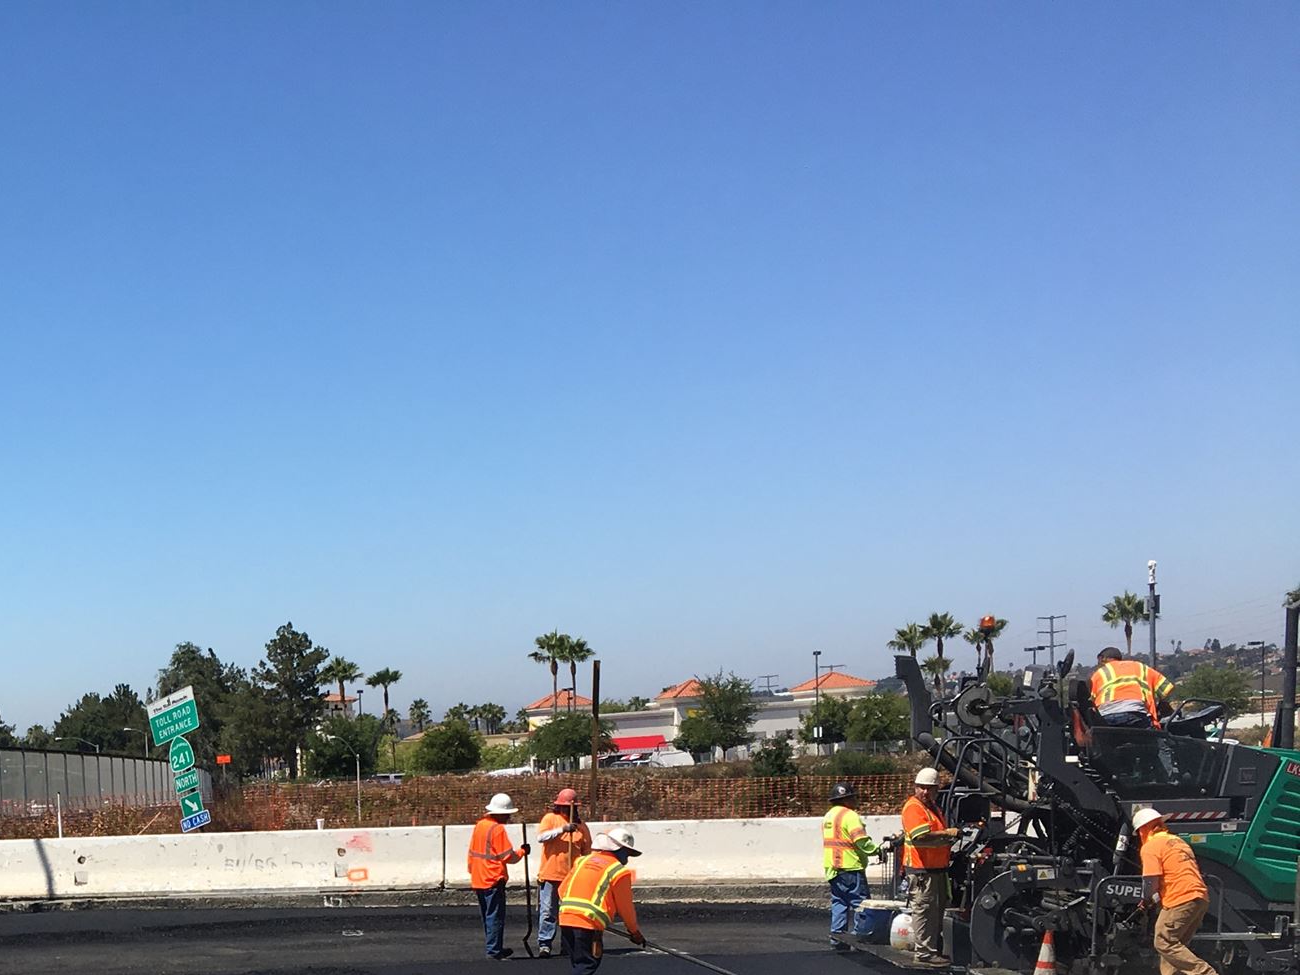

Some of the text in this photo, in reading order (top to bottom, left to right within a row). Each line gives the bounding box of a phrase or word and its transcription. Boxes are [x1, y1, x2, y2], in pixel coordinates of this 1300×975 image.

[155, 705, 191, 728] TOLL ROAD
[158, 717, 193, 739] ENTRANCE
[172, 750, 190, 769] 241
[175, 774, 198, 790] NORTH
[182, 812, 209, 830] NO CASH
[1106, 884, 1145, 898] SUPE
